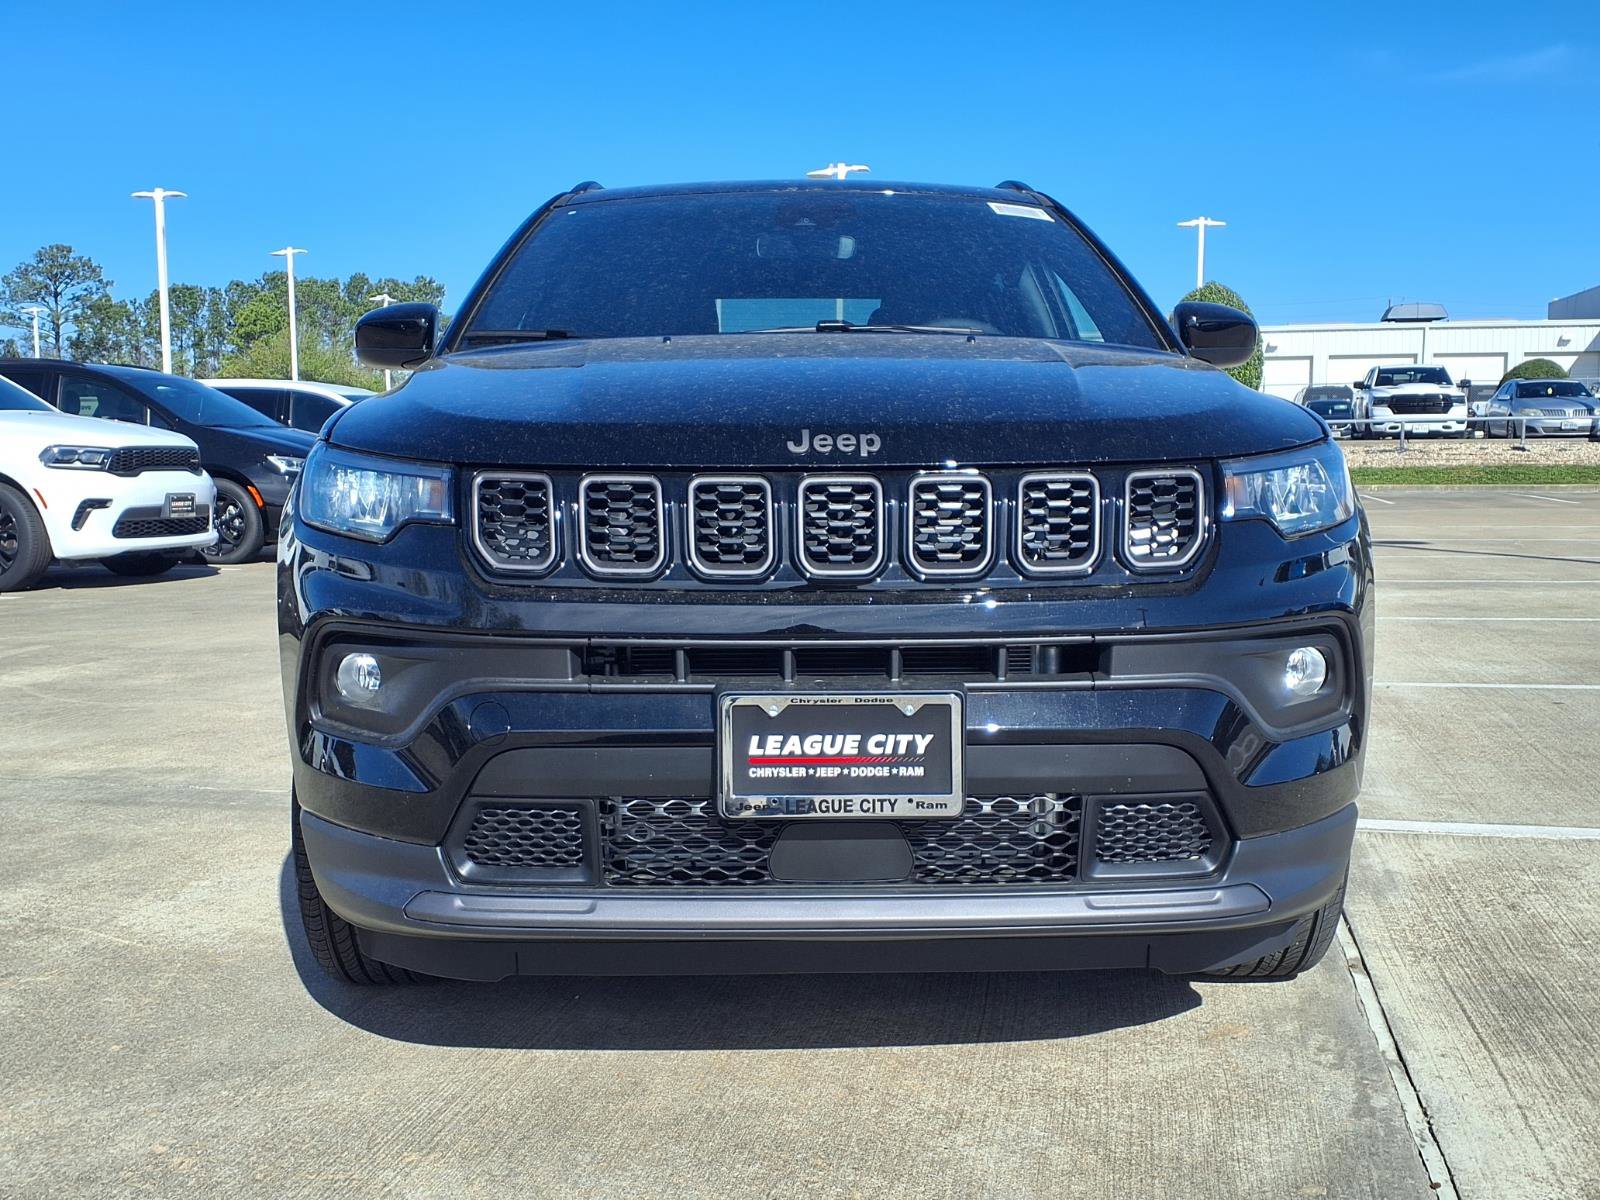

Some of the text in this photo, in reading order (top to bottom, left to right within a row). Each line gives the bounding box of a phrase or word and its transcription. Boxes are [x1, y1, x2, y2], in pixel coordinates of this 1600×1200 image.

[786, 429, 881, 457] Jeep
[748, 734, 934, 756] LEAGUE CITY
[749, 766, 924, 778] CHRYSLER JEEP DODGE RAM
[785, 798, 854, 814] LEAGUE
[859, 798, 898, 813] CITY
[915, 800, 948, 810] Ram
